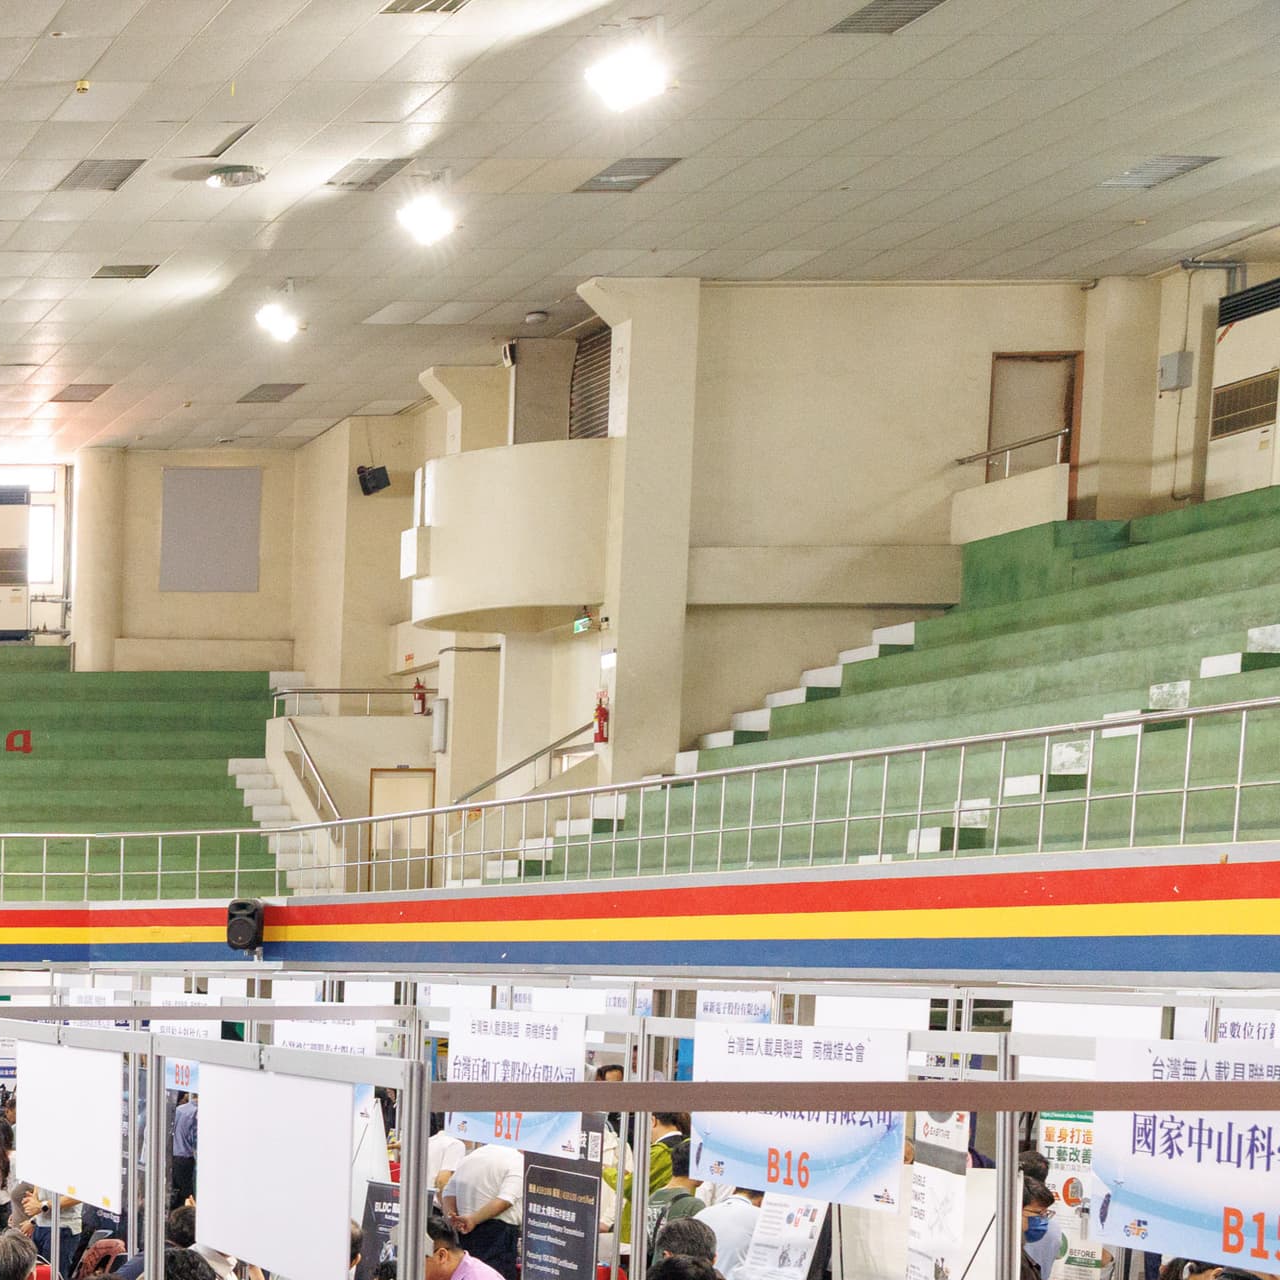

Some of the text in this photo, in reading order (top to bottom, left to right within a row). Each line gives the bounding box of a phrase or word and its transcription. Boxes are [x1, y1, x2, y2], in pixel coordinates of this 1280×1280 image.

[174, 1063, 190, 1087] B19
[493, 1112, 523, 1142] B17
[1044, 1126, 1094, 1145] 量身打造
[1131, 1112, 1280, 1172] 國家中山科
[767, 1147, 810, 1189] B16
[374, 1202, 392, 1214] BLDC
[1222, 1206, 1280, 1261] B1
[1068, 1248, 1097, 1259] BEFORE
